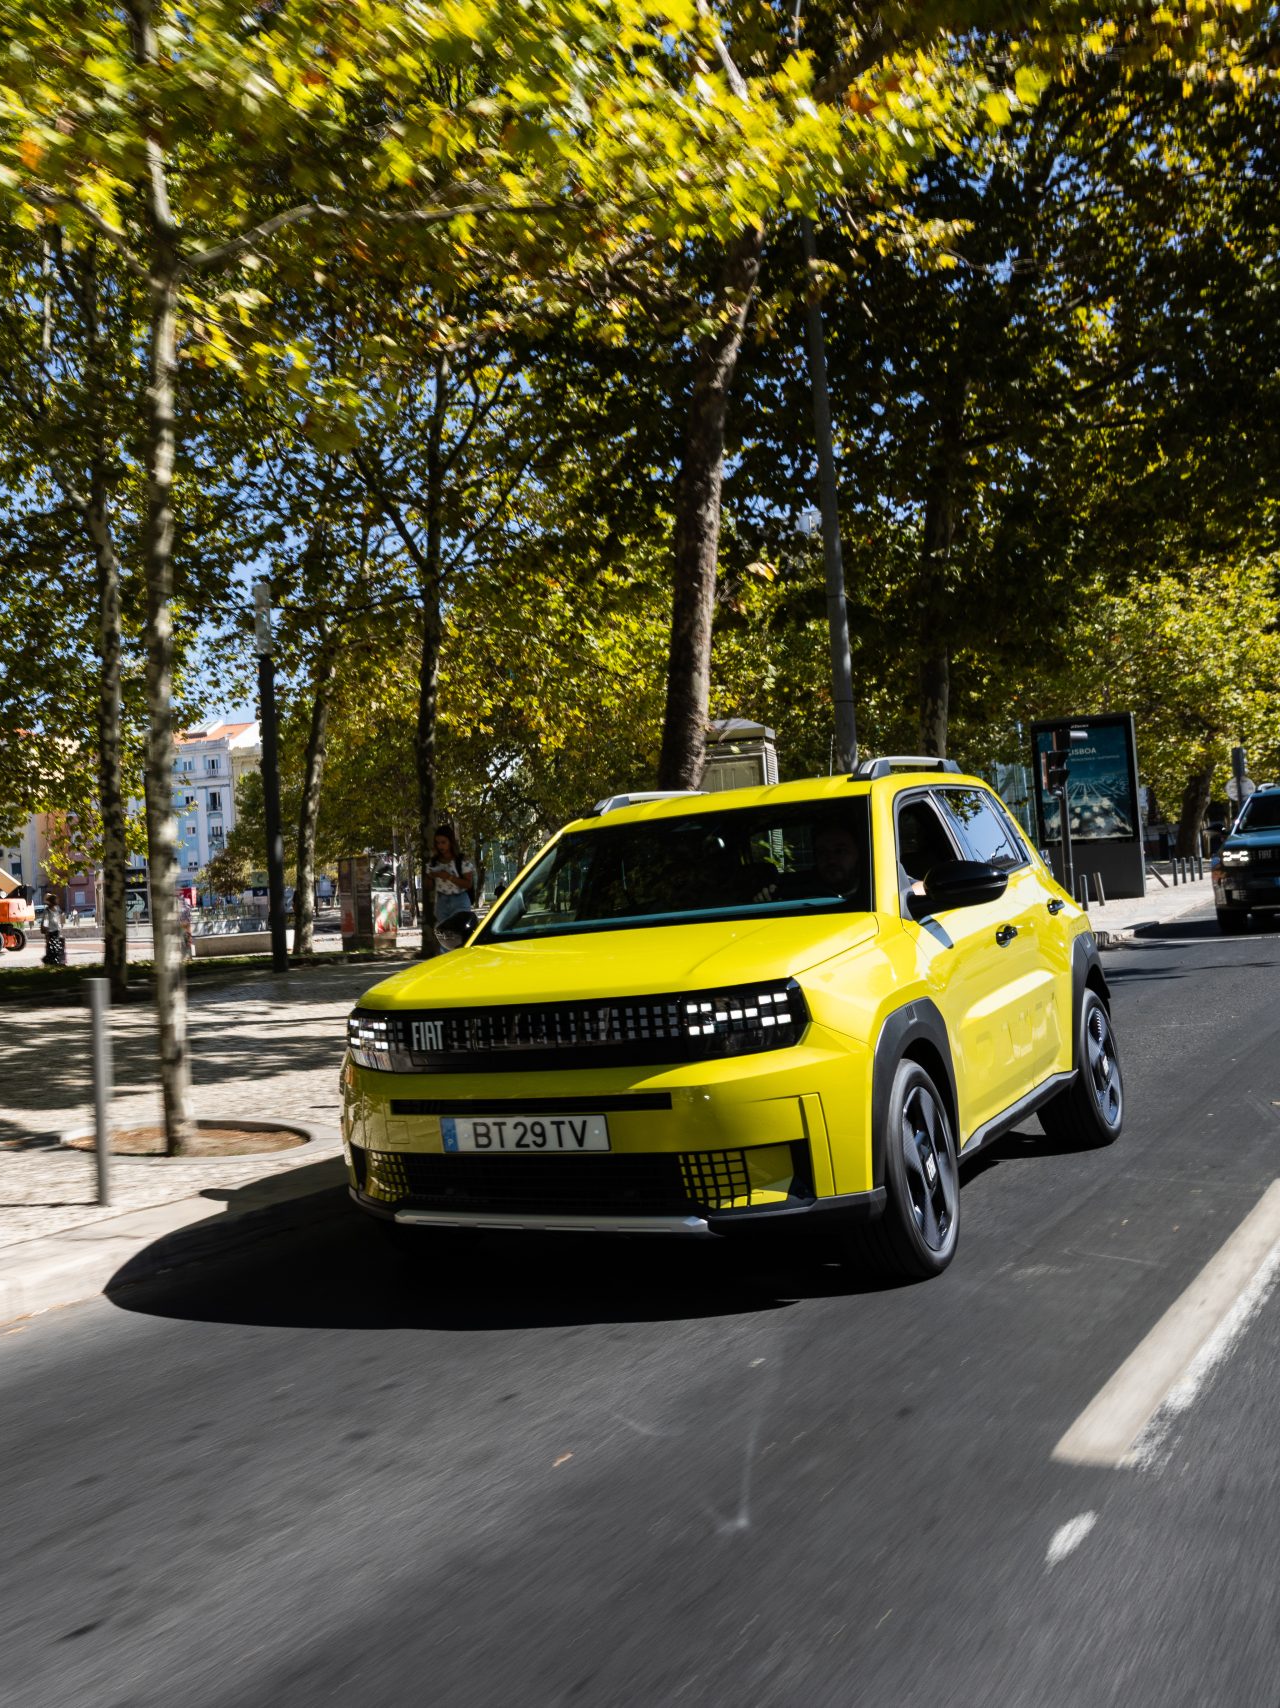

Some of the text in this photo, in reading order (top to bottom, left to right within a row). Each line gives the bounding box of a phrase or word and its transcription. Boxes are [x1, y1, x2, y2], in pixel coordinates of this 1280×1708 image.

[411, 1020, 444, 1050] FIAT
[472, 1121, 507, 1149] BT
[513, 1121, 547, 1148] 29
[550, 1120, 587, 1148] TV
